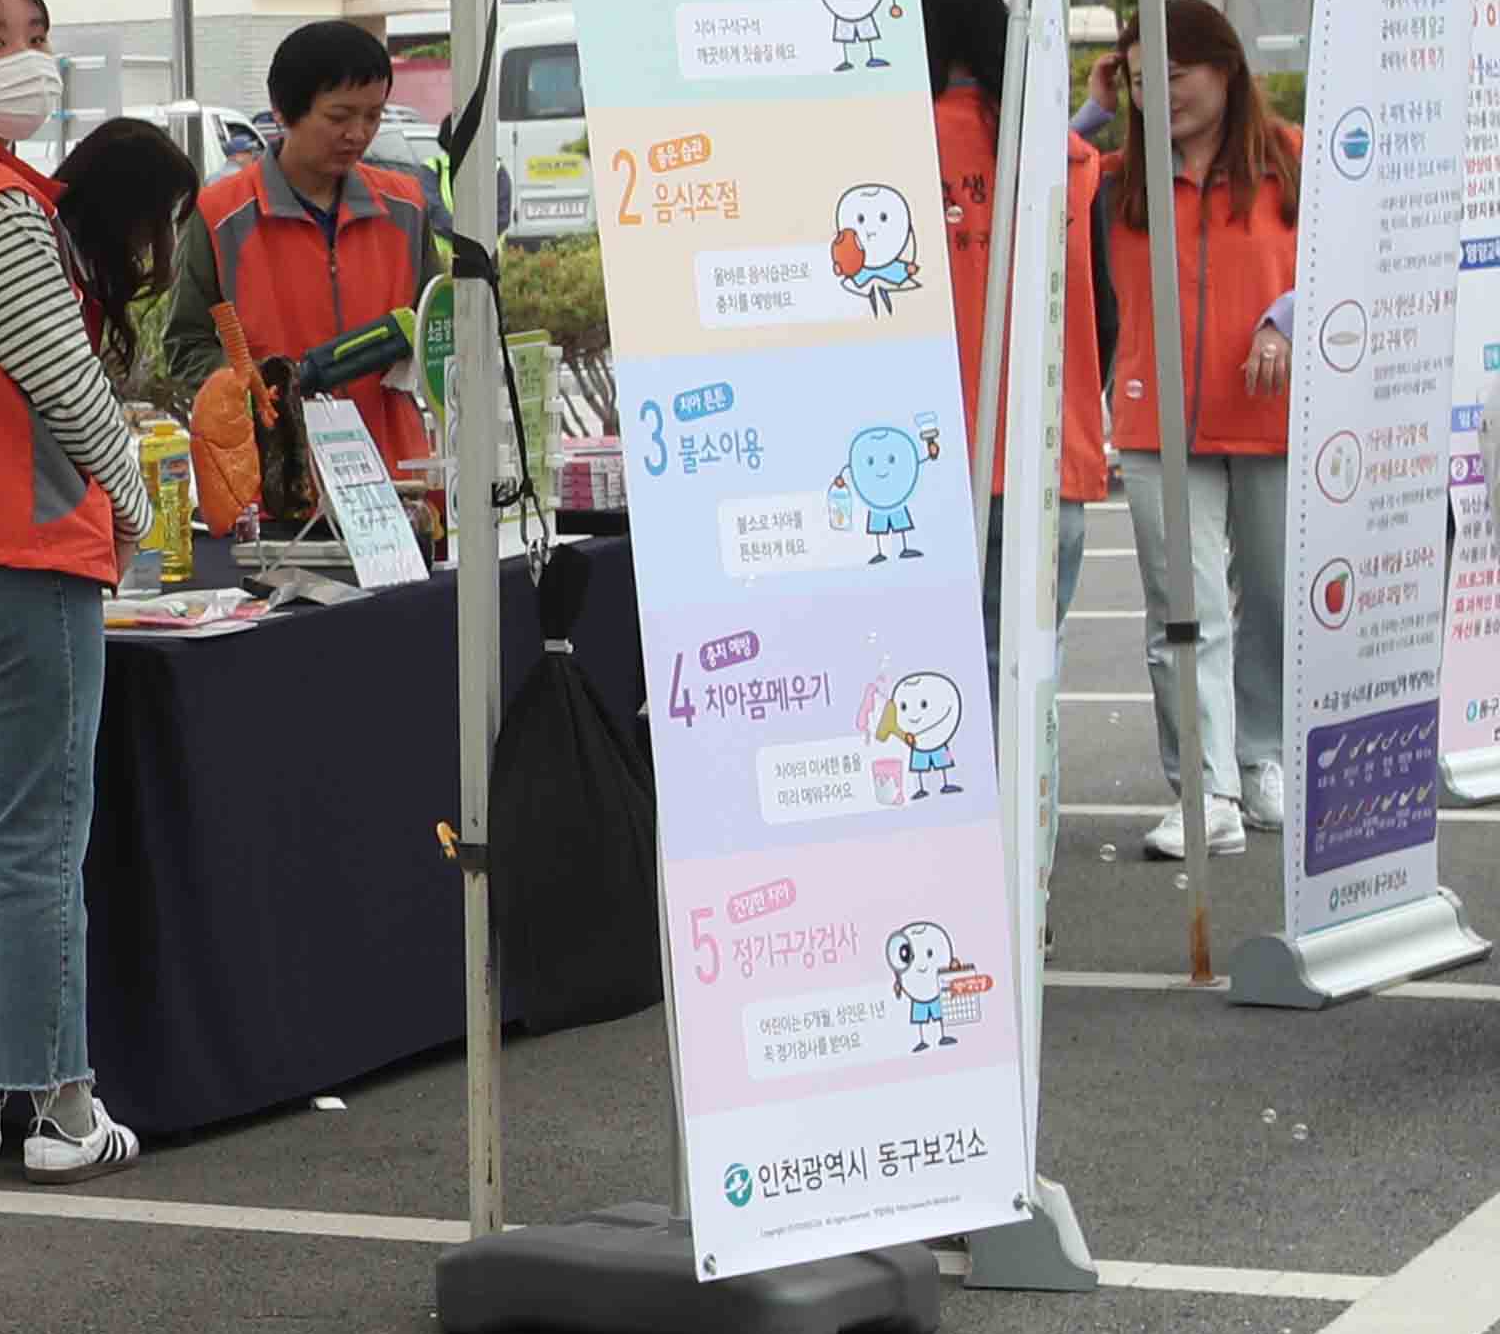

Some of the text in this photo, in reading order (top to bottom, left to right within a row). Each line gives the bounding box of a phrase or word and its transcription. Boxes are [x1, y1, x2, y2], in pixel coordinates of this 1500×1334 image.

[611, 147, 643, 226] 2
[651, 178, 741, 224] 음식조절
[640, 400, 668, 476] 3
[678, 427, 765, 475] 불소이용
[668, 651, 697, 728] 4
[705, 670, 833, 721] 치아홈메우기
[689, 906, 720, 985] 5
[731, 922, 861, 979] 정기구강검사
[757, 1126, 989, 1199] 인천광역시 동구보건소
